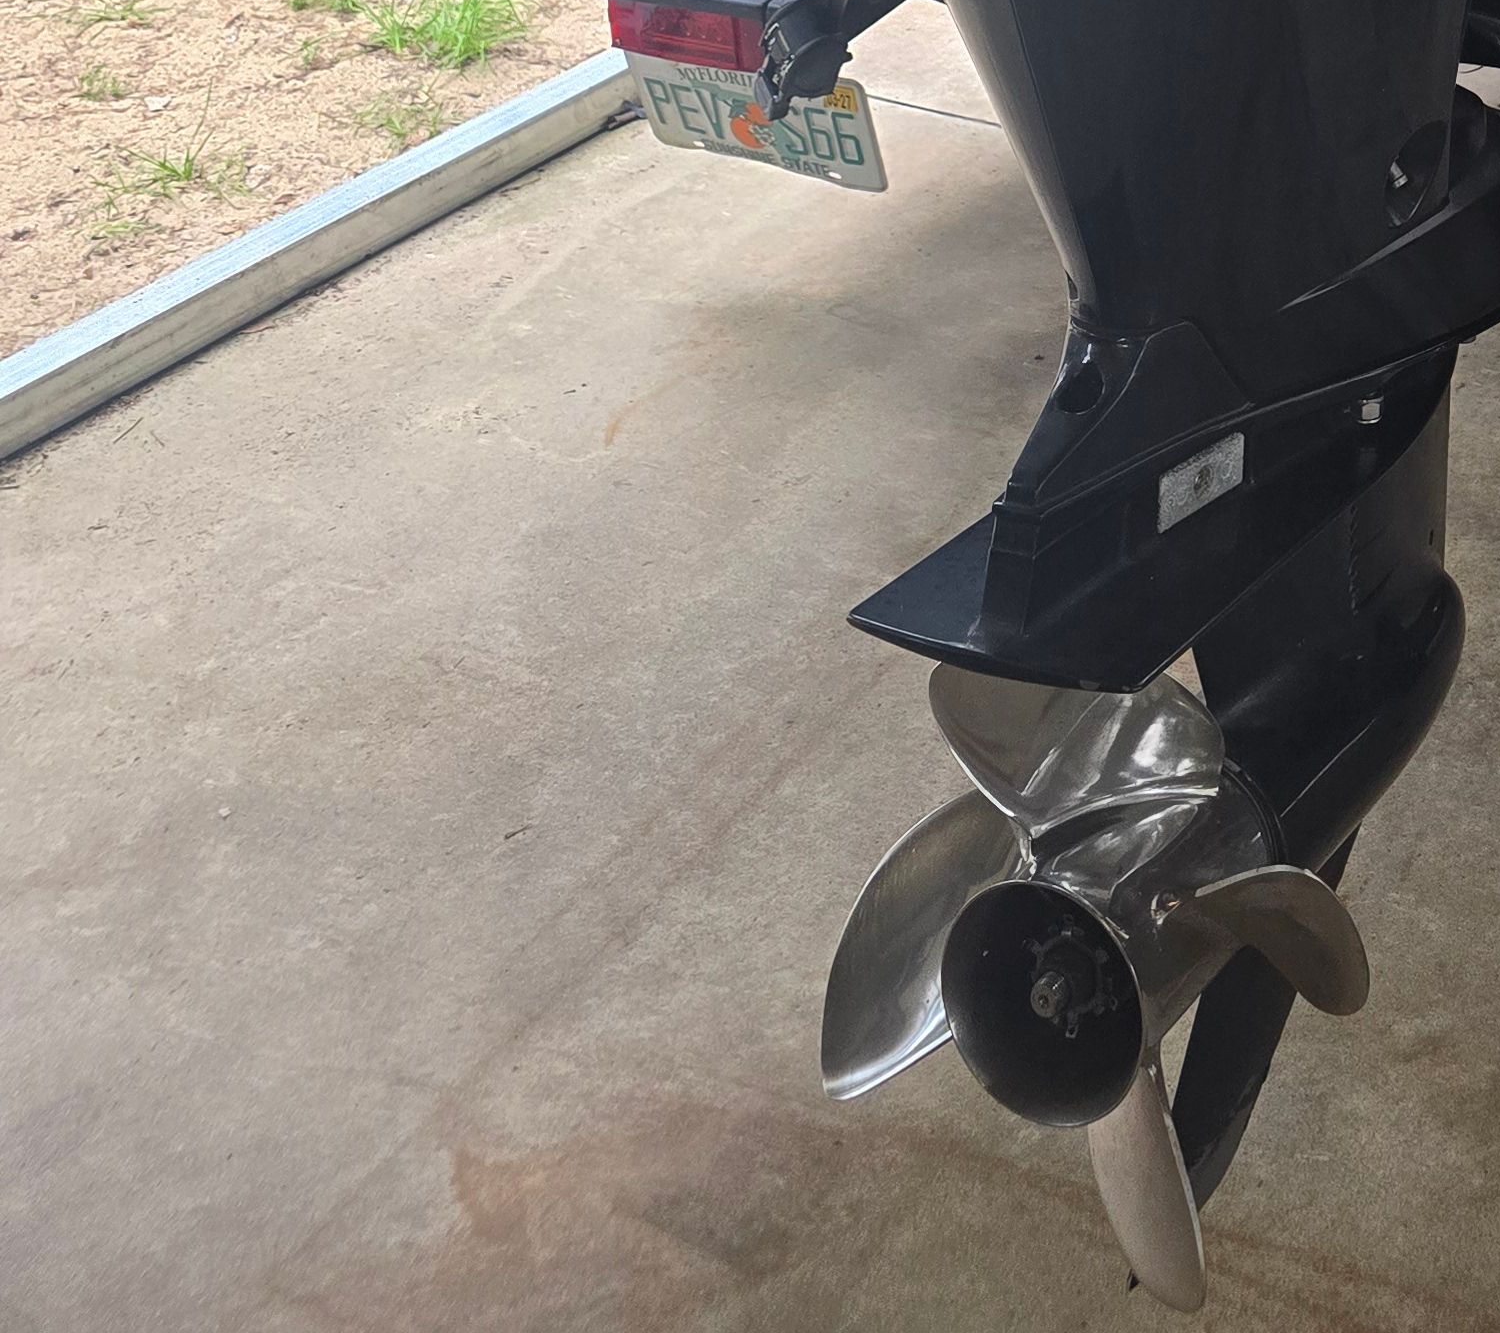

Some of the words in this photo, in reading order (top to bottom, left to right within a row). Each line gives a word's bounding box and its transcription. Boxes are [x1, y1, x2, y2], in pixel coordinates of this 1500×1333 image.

[643, 76, 725, 139] PEV
[779, 105, 865, 166] S66
[780, 156, 829, 178] STATE
